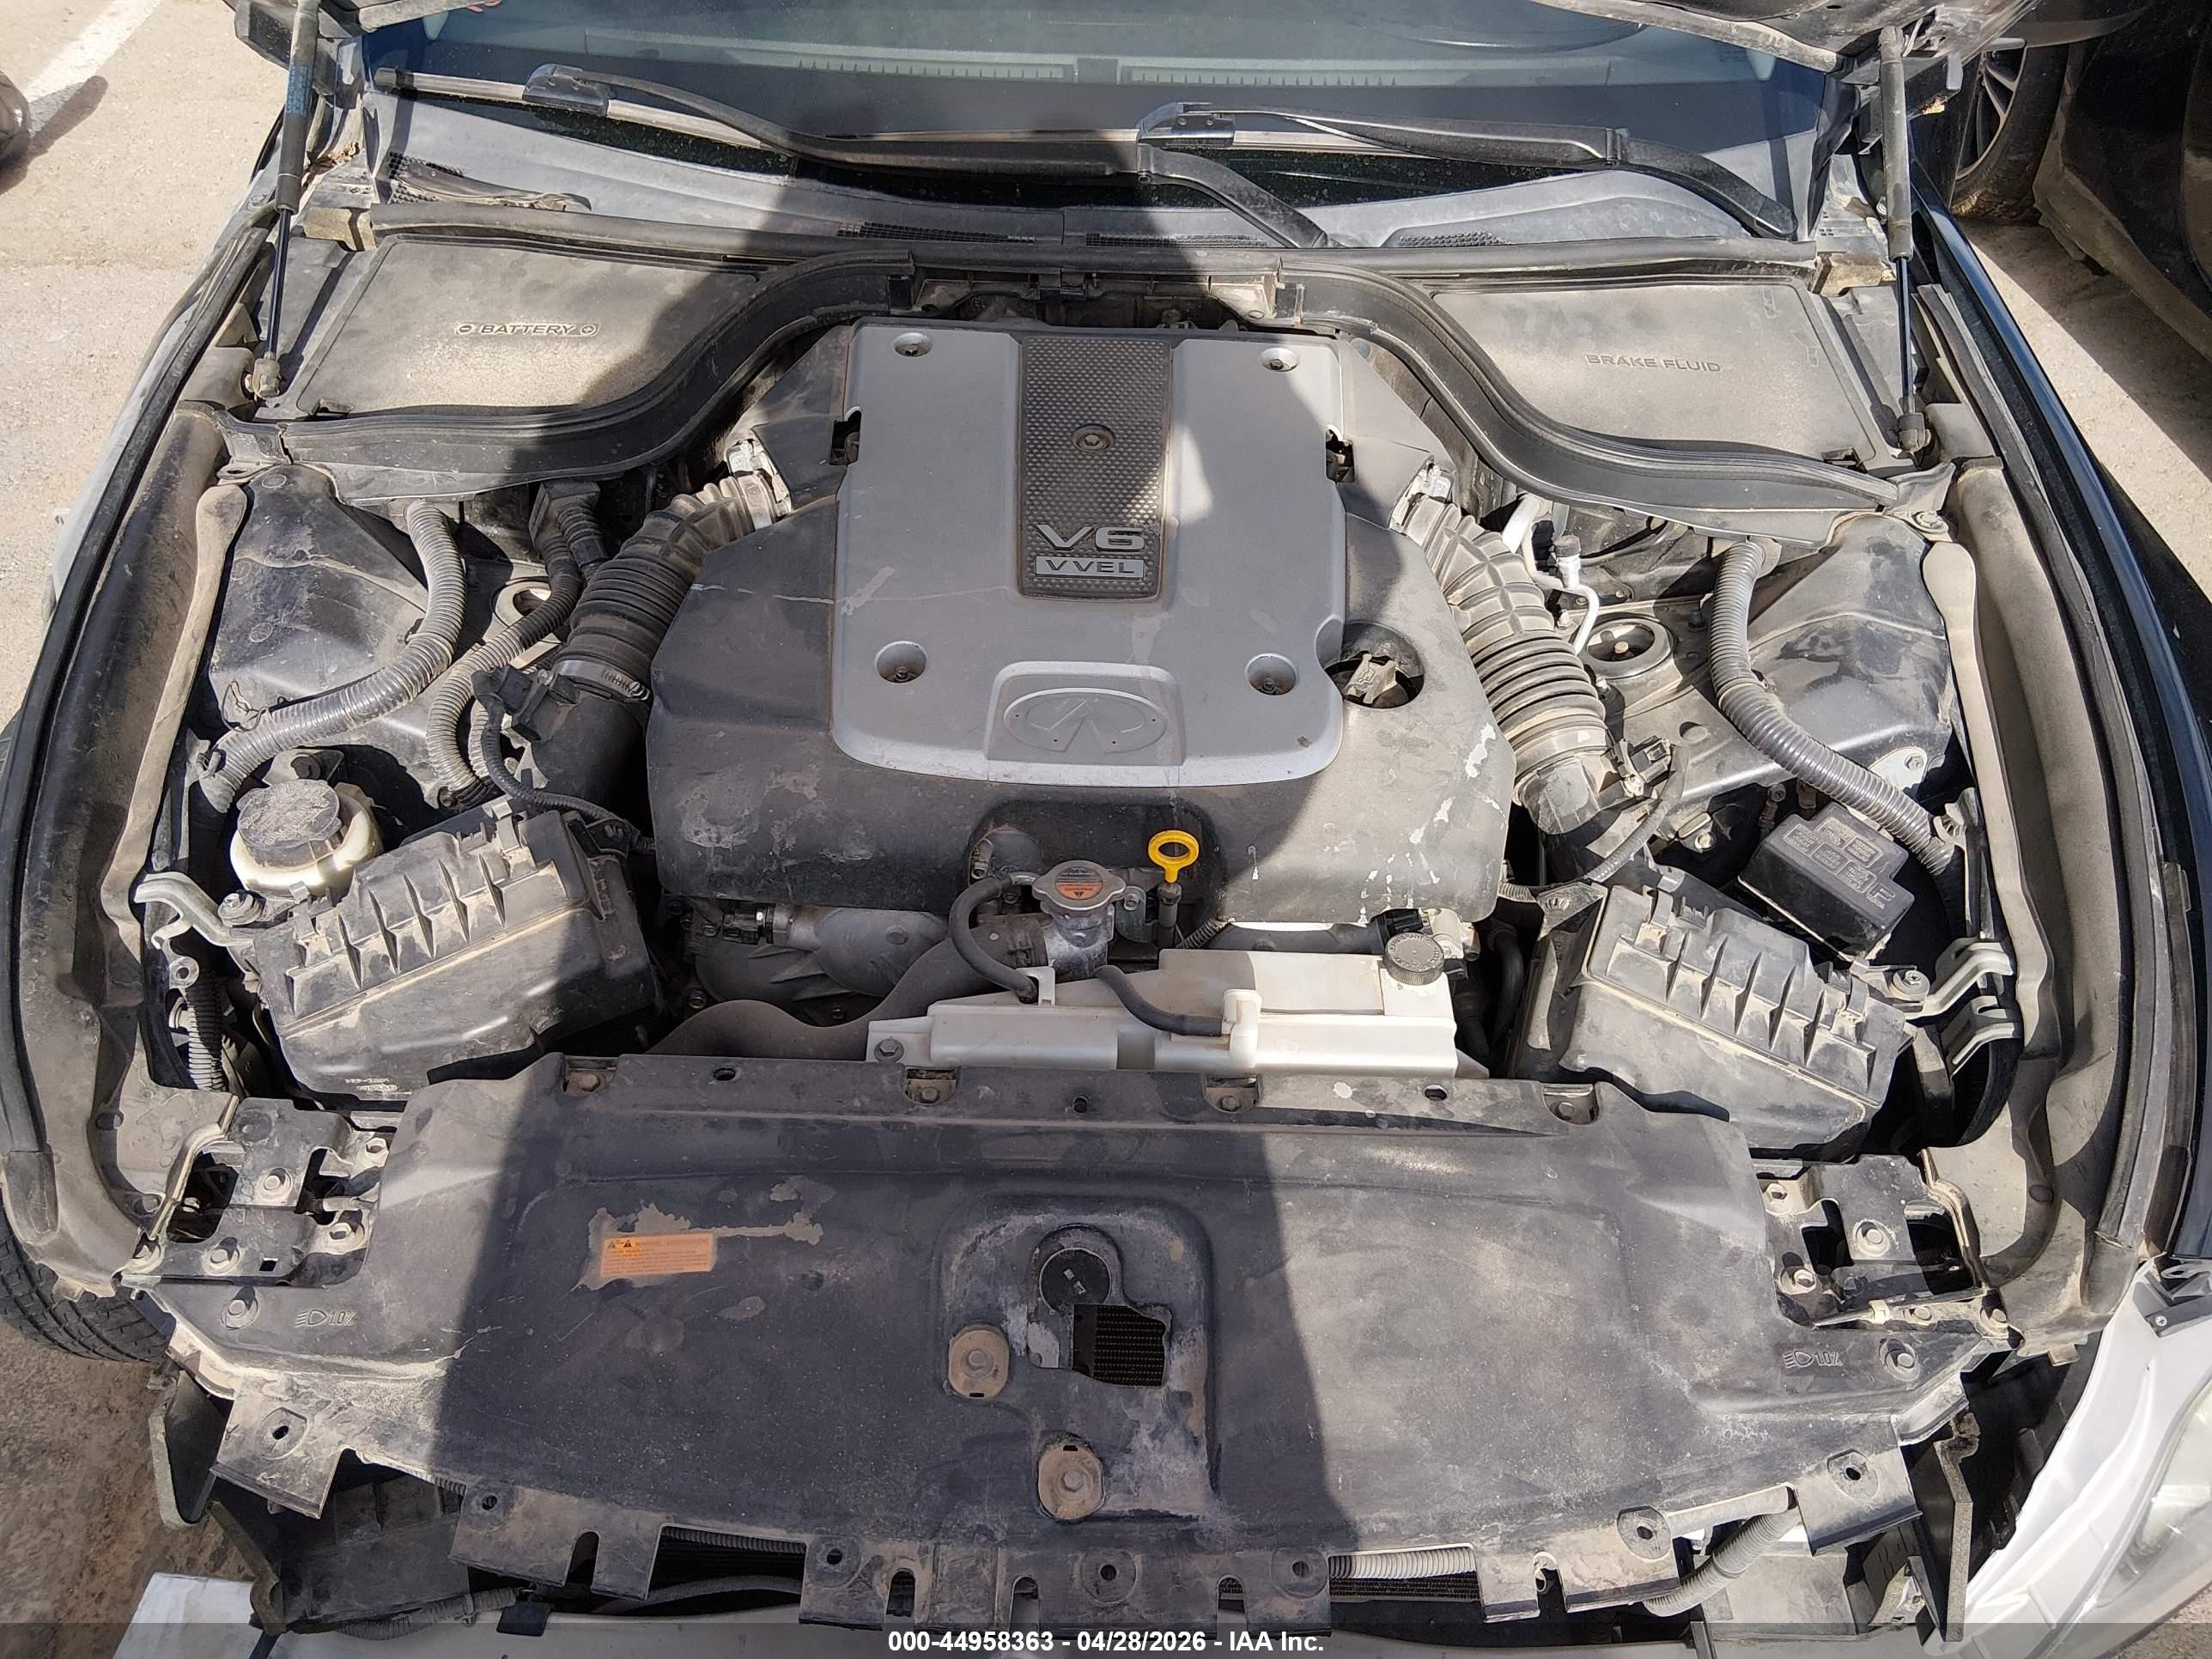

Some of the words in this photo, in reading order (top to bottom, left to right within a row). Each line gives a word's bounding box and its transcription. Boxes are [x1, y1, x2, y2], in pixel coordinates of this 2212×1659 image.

[480, 324, 575, 335] BATTERY
[1586, 354, 1658, 368] BRAKE
[1662, 358, 1722, 372] FLUID
[1033, 524, 1146, 550] V6
[1045, 559, 1135, 574] VVEL
